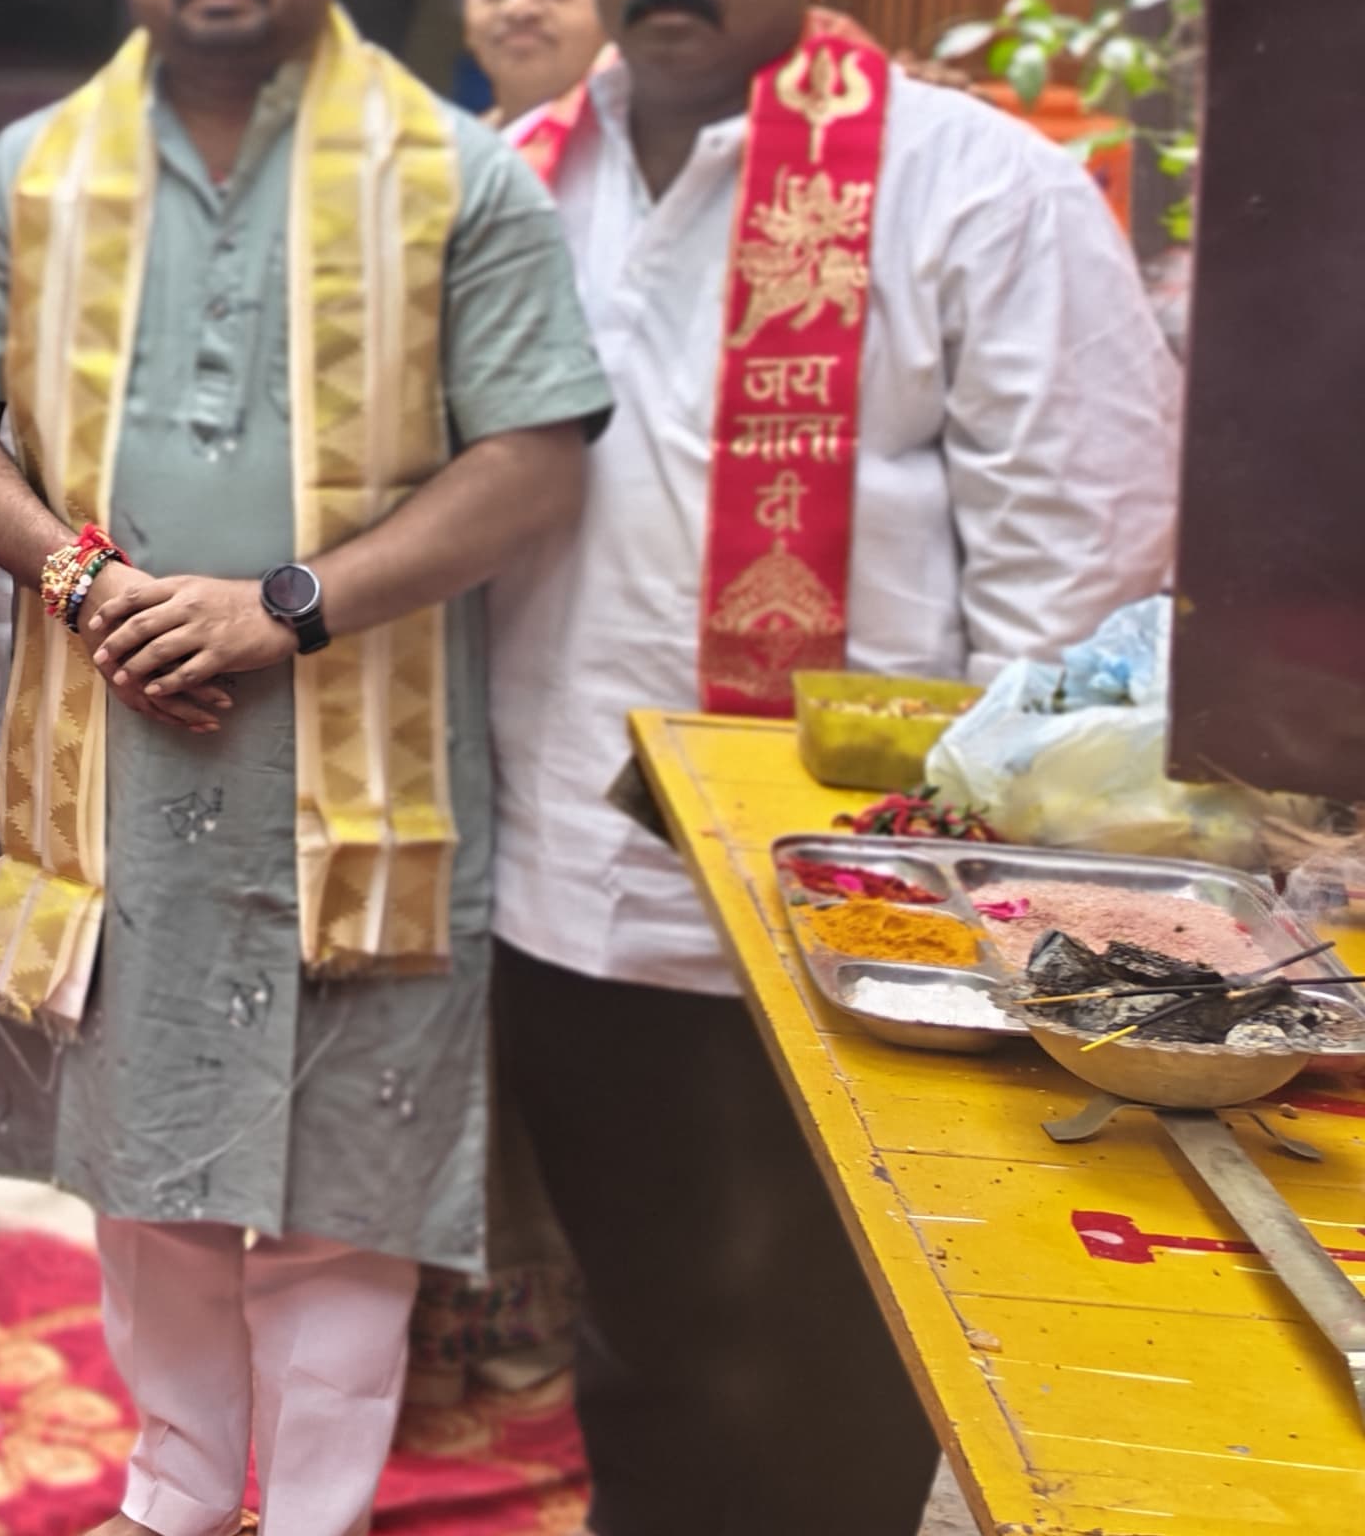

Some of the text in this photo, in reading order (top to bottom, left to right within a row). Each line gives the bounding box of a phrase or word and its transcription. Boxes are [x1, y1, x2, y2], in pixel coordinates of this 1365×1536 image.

[744, 355, 840, 406] जय
[731, 415, 847, 462] माता
[754, 468, 810, 533] दी
